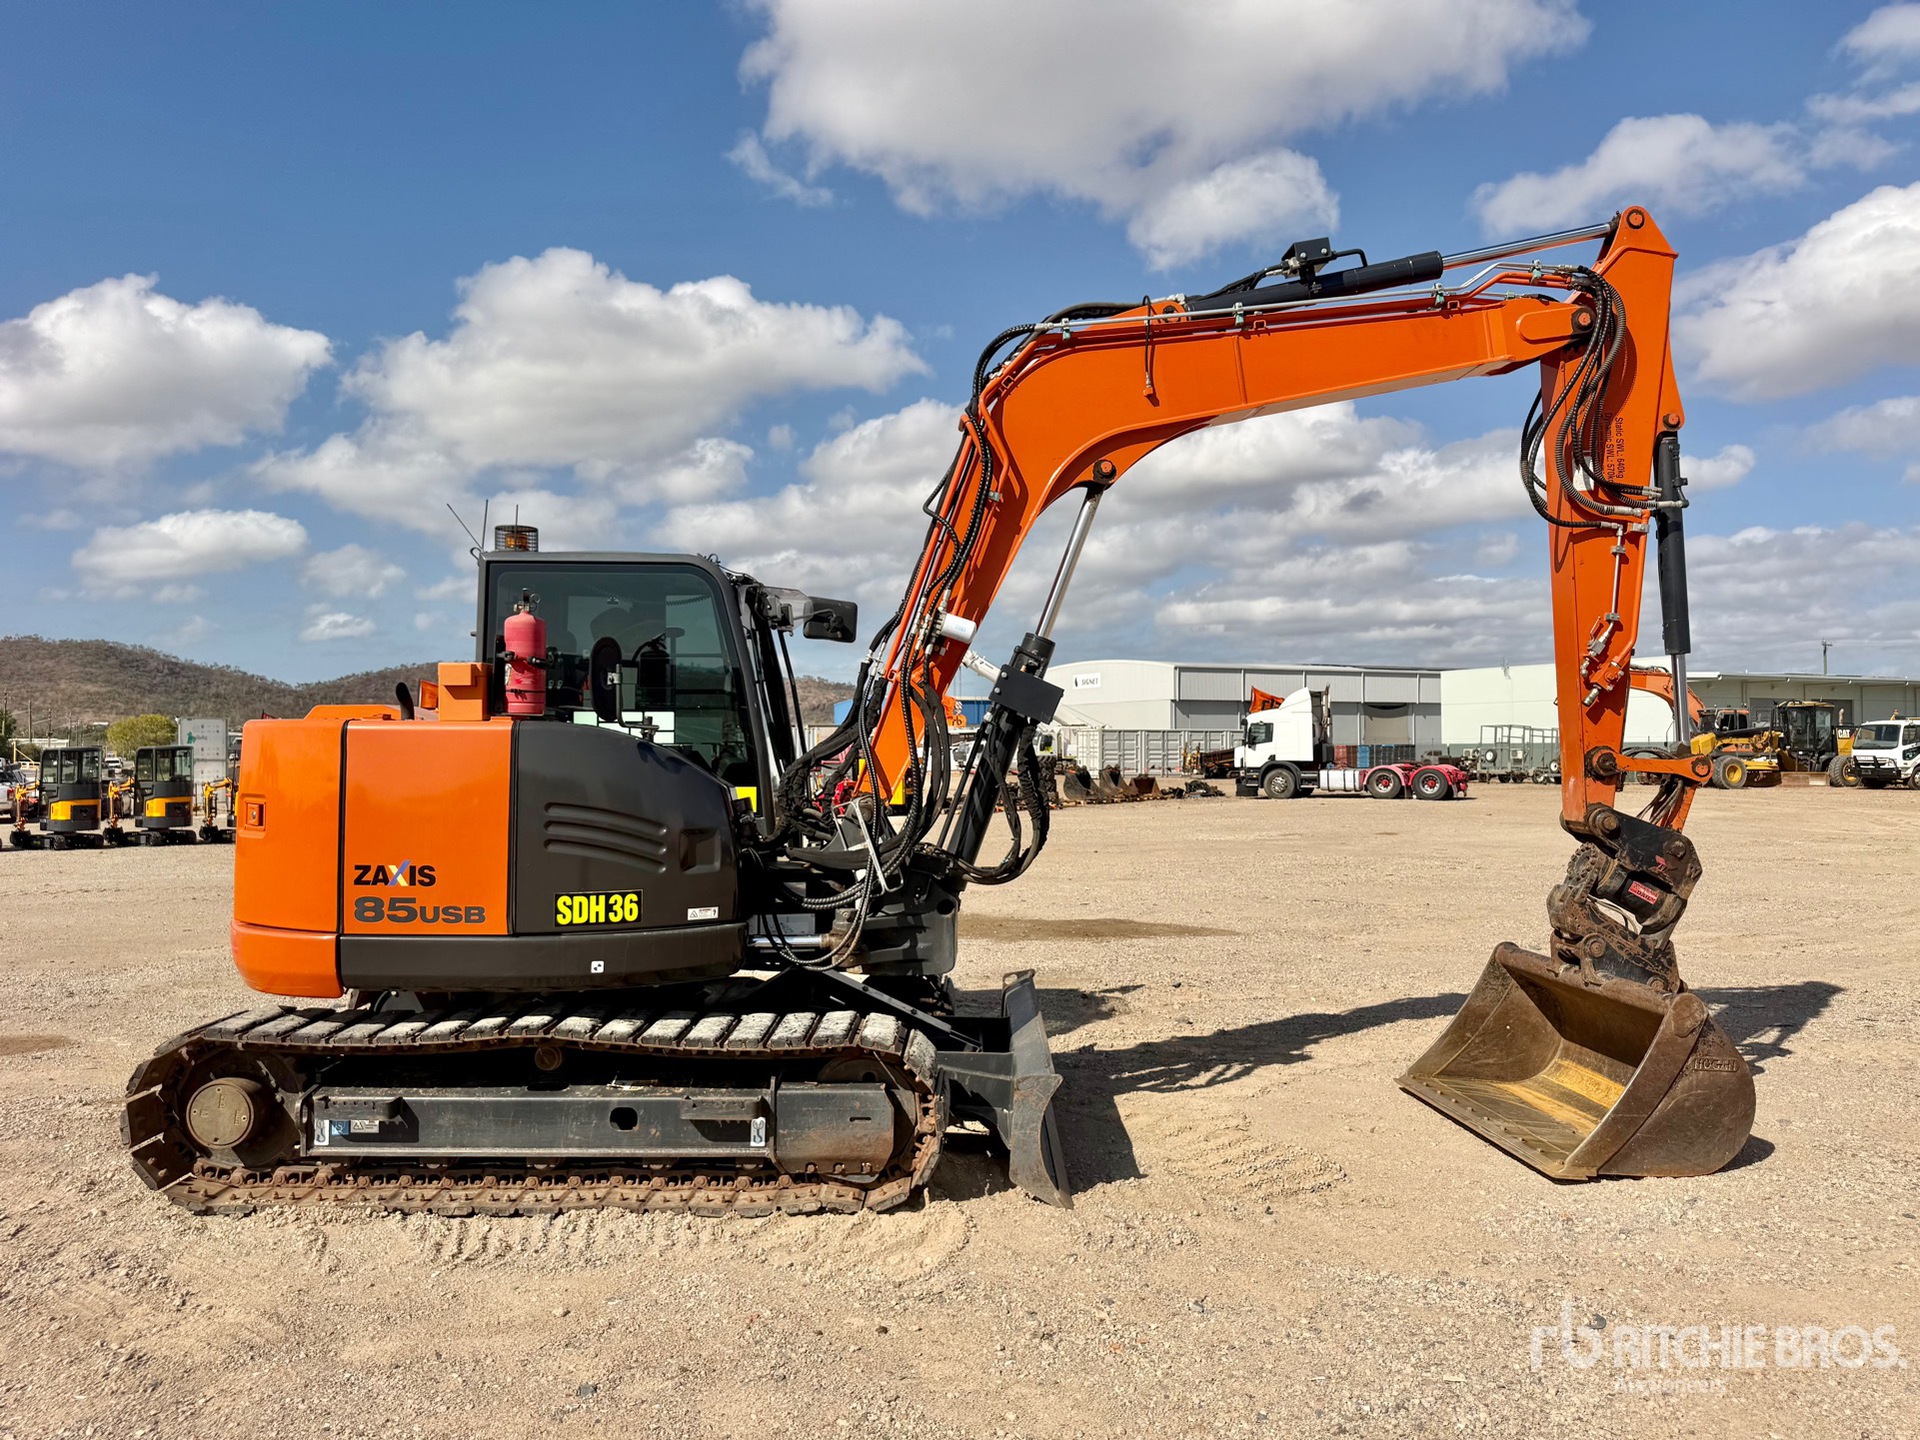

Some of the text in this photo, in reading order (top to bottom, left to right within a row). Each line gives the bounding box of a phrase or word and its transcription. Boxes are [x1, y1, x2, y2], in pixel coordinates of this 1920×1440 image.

[1606, 444, 1615, 462] SWL:
[1614, 417, 1626, 479] Static SWL: 640kg
[1838, 729, 1850, 738] CAT
[353, 859, 437, 887] ZAXIS
[1693, 1058, 1737, 1071] HOGAN
